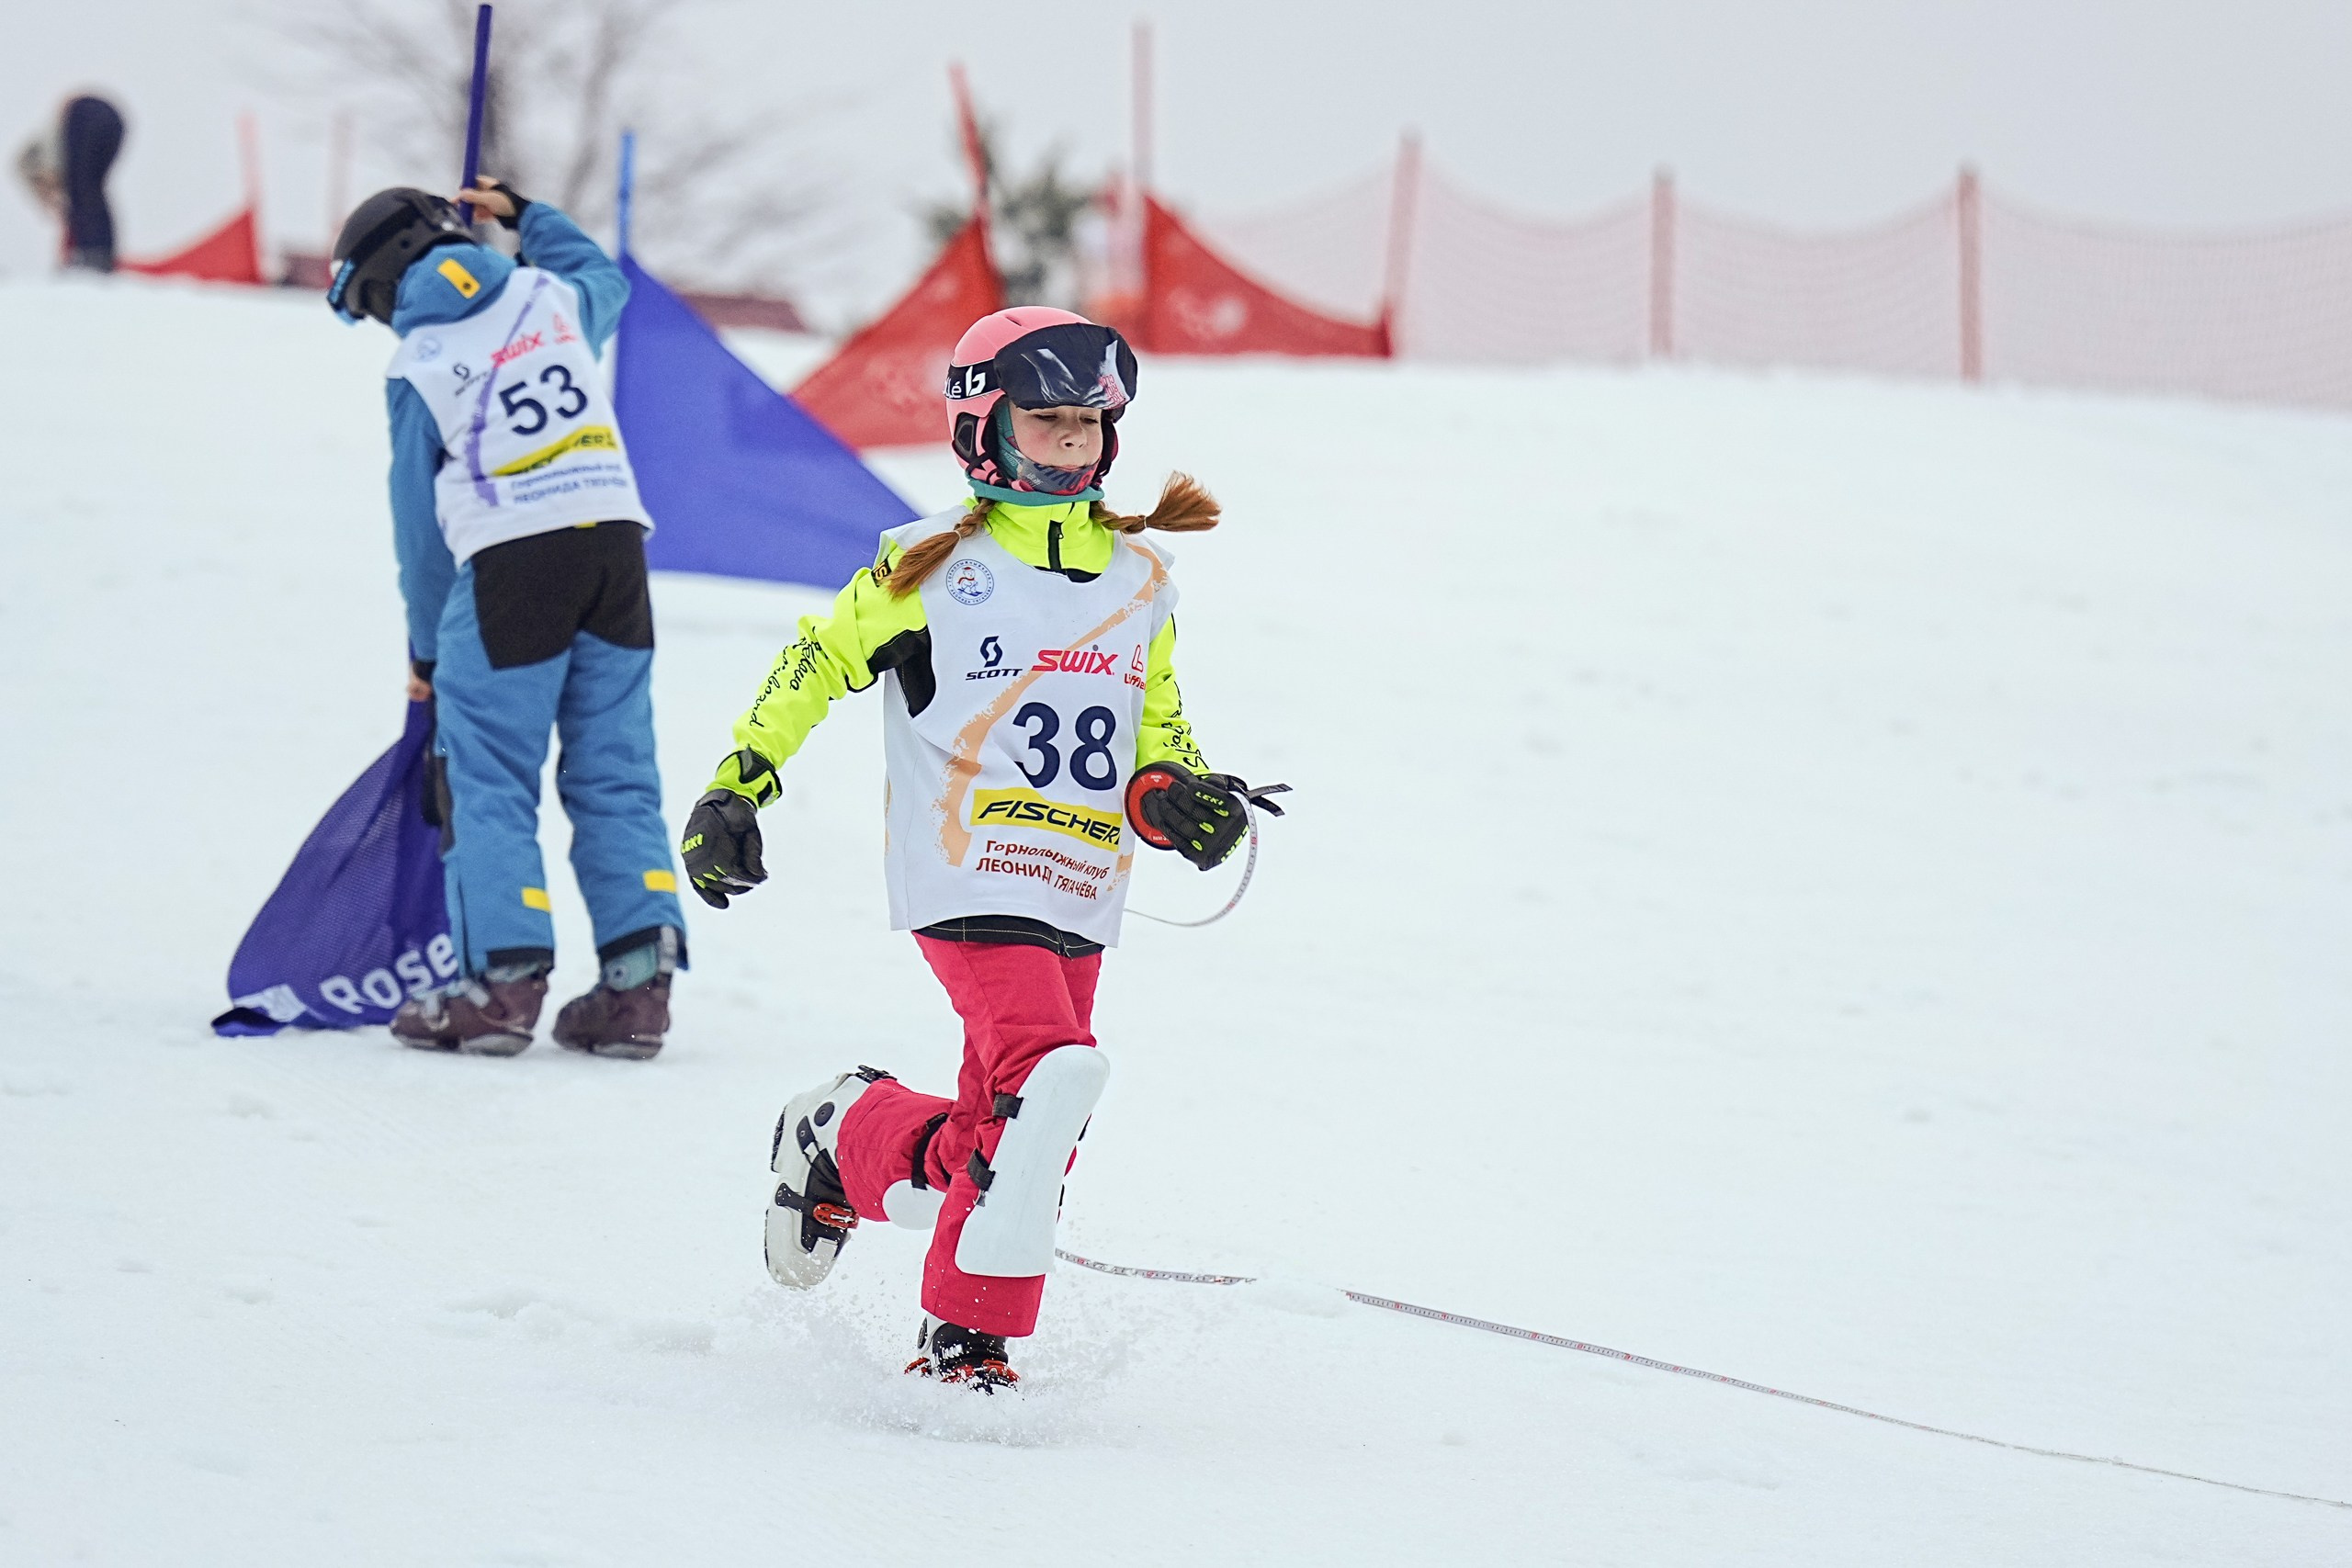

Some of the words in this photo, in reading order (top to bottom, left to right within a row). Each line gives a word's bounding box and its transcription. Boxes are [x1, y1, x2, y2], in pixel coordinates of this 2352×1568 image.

[499, 365, 587, 435] 53
[966, 668, 1023, 681] SCOTT
[1012, 702, 1117, 791] 38
[1195, 791, 1224, 806] LEKI
[976, 858, 1053, 885] ЛЕОНИД
[986, 840, 1086, 873] Горнолыжный
[1083, 864, 1110, 881] клуб
